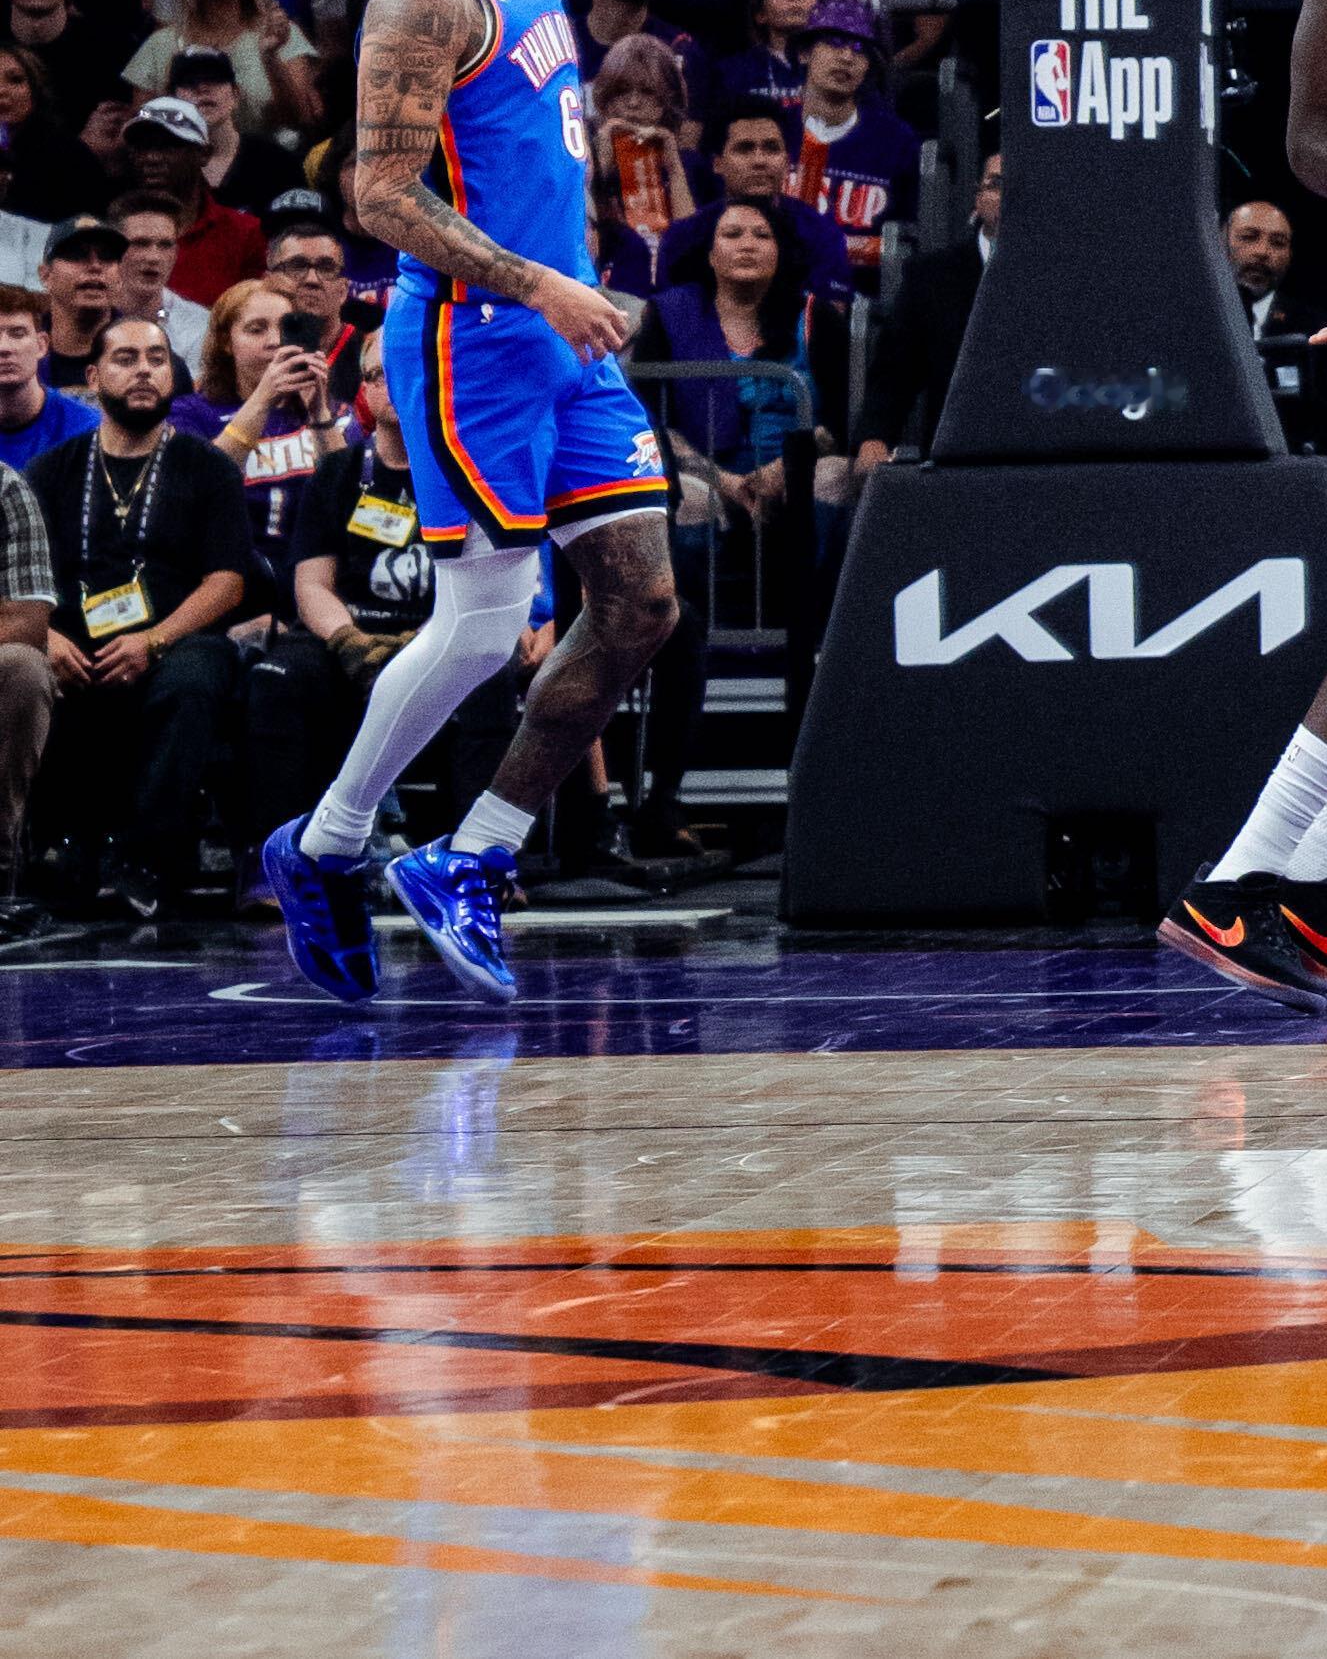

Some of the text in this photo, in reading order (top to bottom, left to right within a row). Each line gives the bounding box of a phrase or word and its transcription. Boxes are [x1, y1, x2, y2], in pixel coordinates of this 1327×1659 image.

[507, 12, 578, 93] THUND
[1076, 40, 1174, 140] App
[559, 86, 587, 160] 6
[894, 557, 1306, 666] KIA
